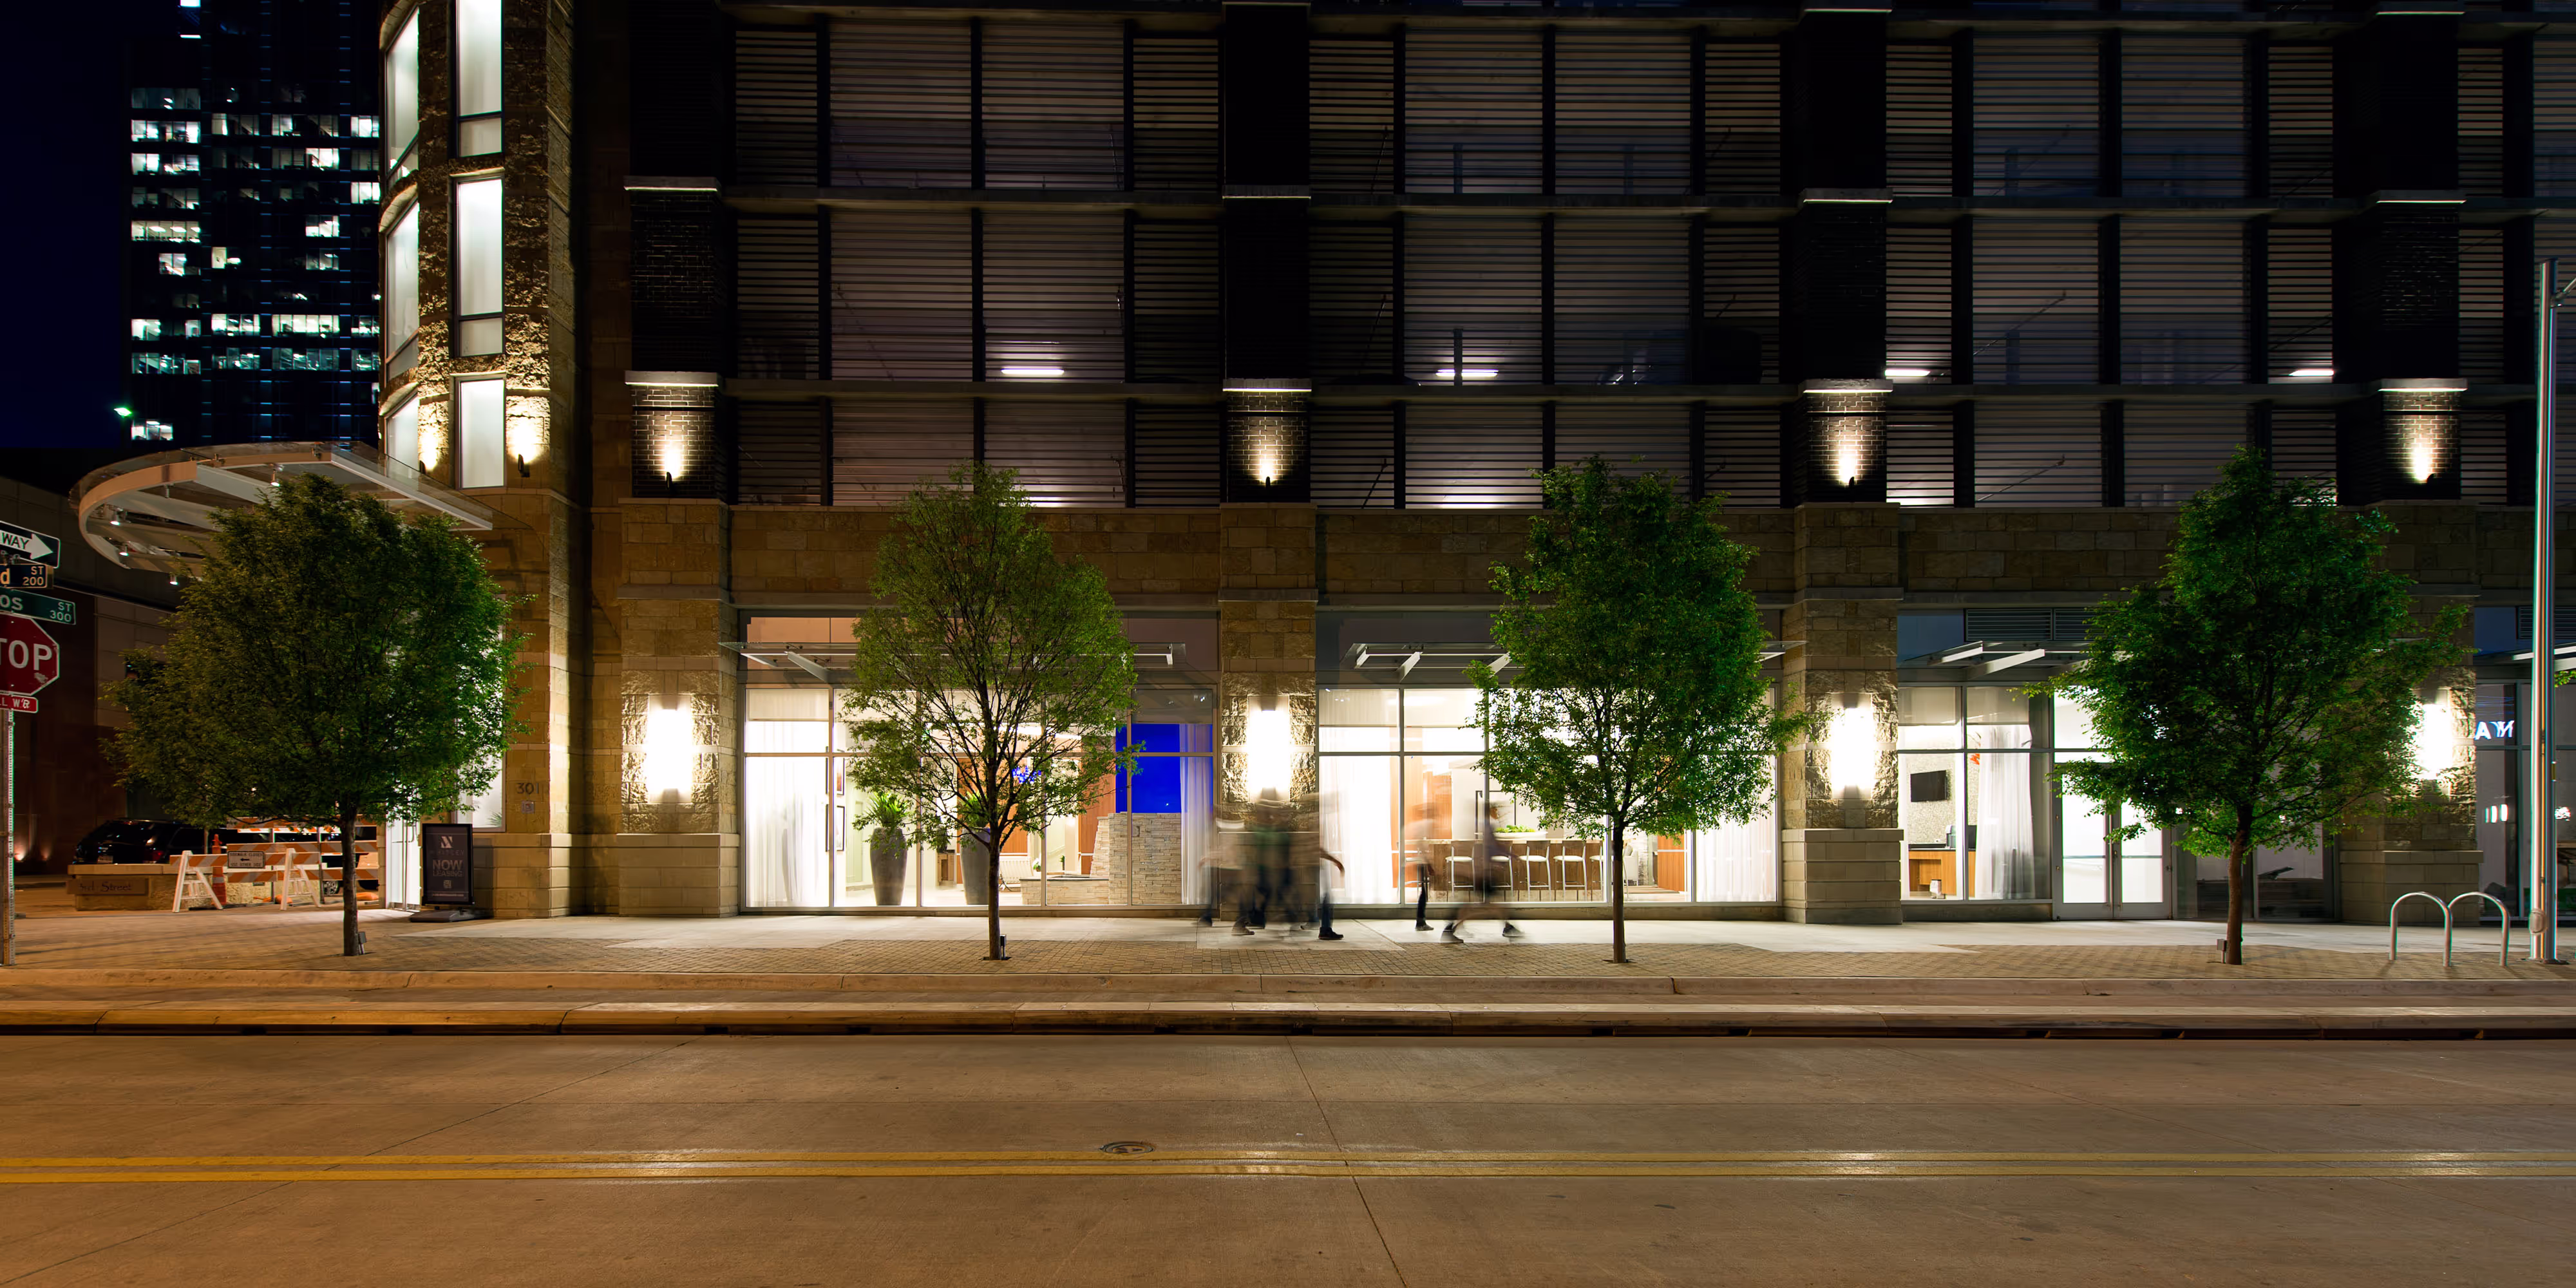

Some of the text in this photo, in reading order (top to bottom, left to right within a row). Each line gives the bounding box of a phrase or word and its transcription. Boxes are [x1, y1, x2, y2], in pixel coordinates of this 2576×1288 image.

[2, 532, 29, 550] WAY
[31, 566, 44, 575] ST
[23, 576, 44, 585] 200
[58, 601, 72, 612] ST
[50, 610, 71, 622] 300
[516, 782, 539, 794] 301
[433, 860, 463, 870] NOW
[101, 881, 132, 892] Street
